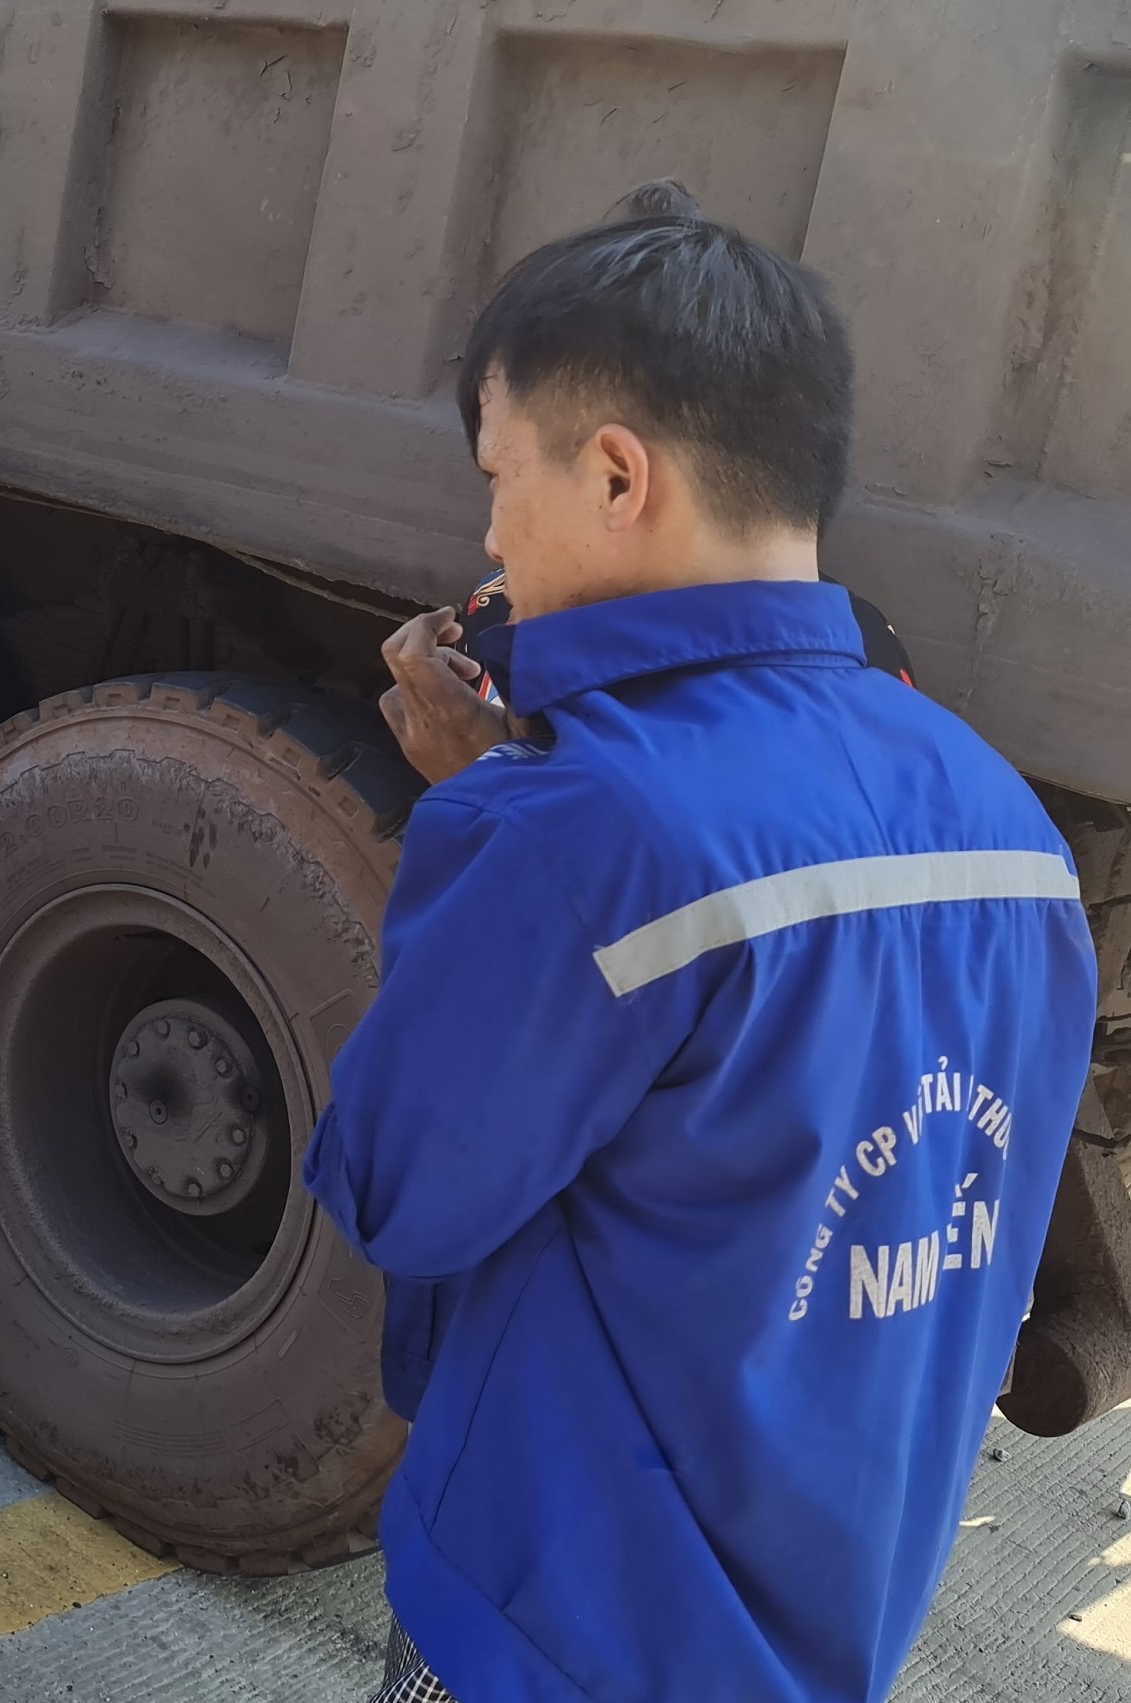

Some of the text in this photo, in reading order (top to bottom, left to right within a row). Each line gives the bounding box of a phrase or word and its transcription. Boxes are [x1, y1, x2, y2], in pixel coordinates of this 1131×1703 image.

[825, 1165, 860, 1217] TY
[856, 1126, 897, 1177] CP
[921, 1055, 961, 1114] TẢI
[849, 1230, 940, 1319] NAM
